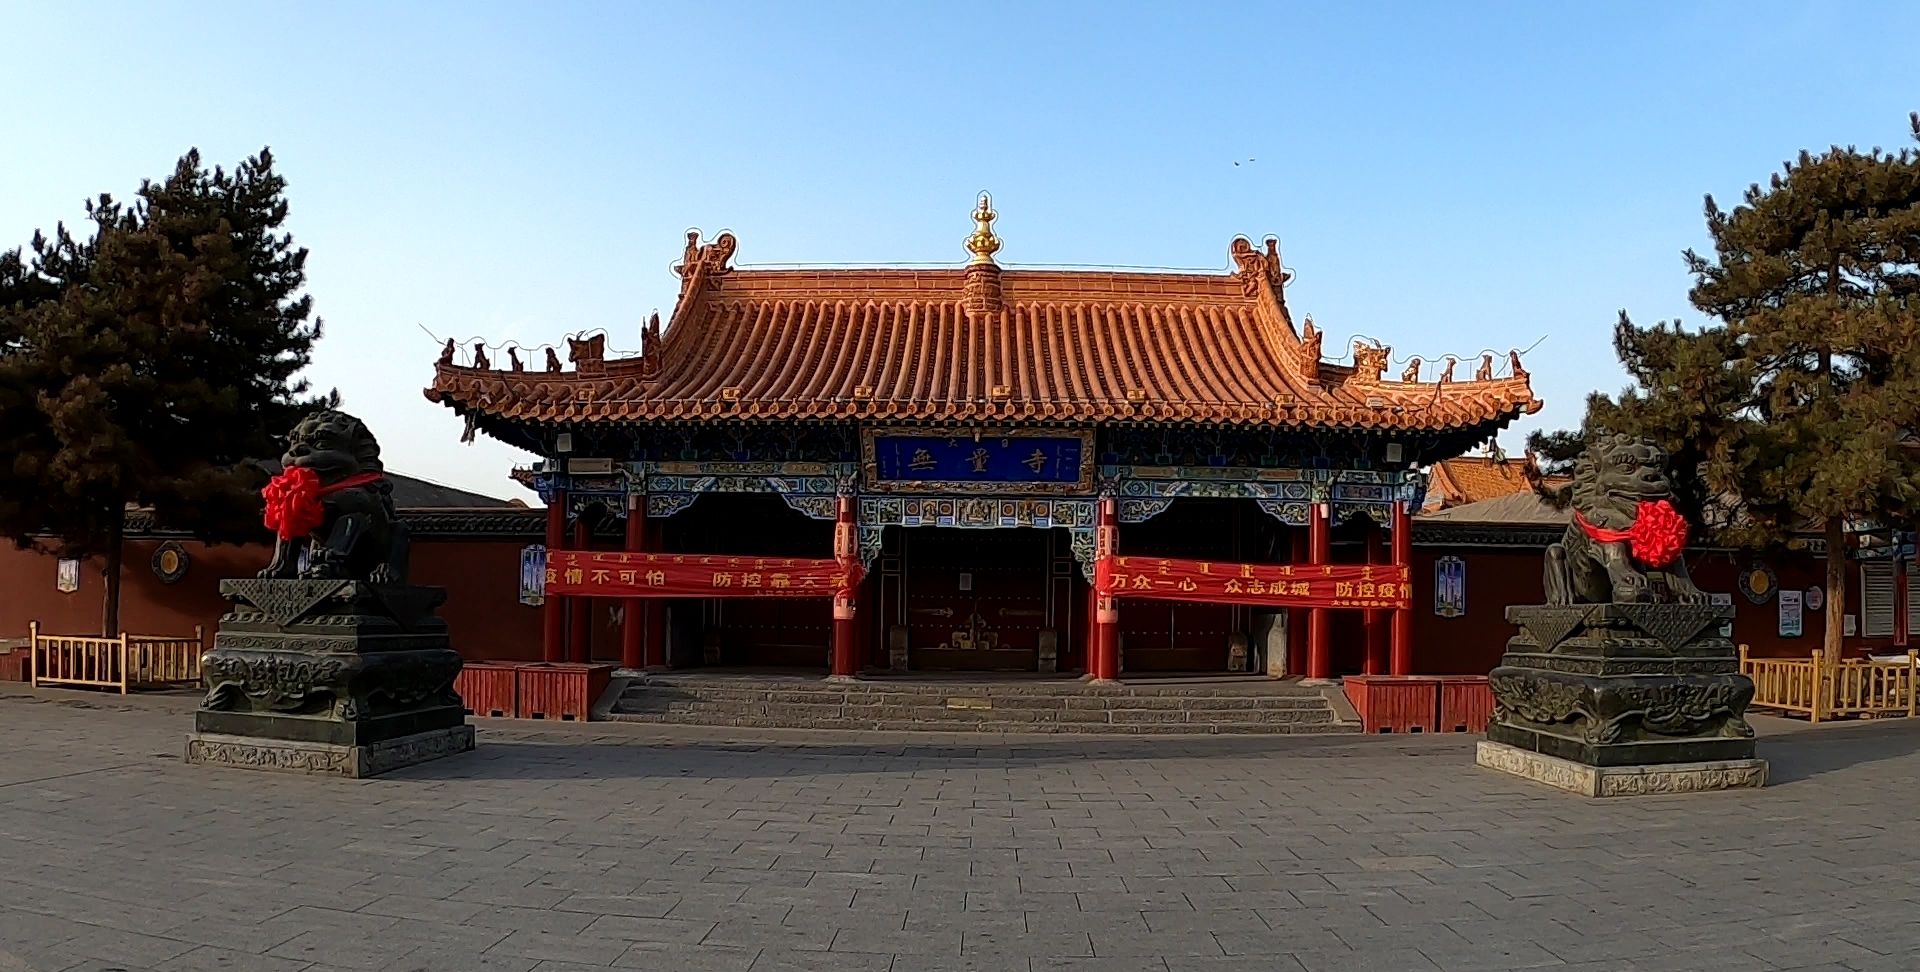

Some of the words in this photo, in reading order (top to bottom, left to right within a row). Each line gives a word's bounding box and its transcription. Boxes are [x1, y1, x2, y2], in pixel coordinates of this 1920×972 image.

[545, 567, 665, 586] 疫情不可怕
[1109, 573, 1198, 591] 万众一心
[1223, 578, 1310, 596] 众志成城
